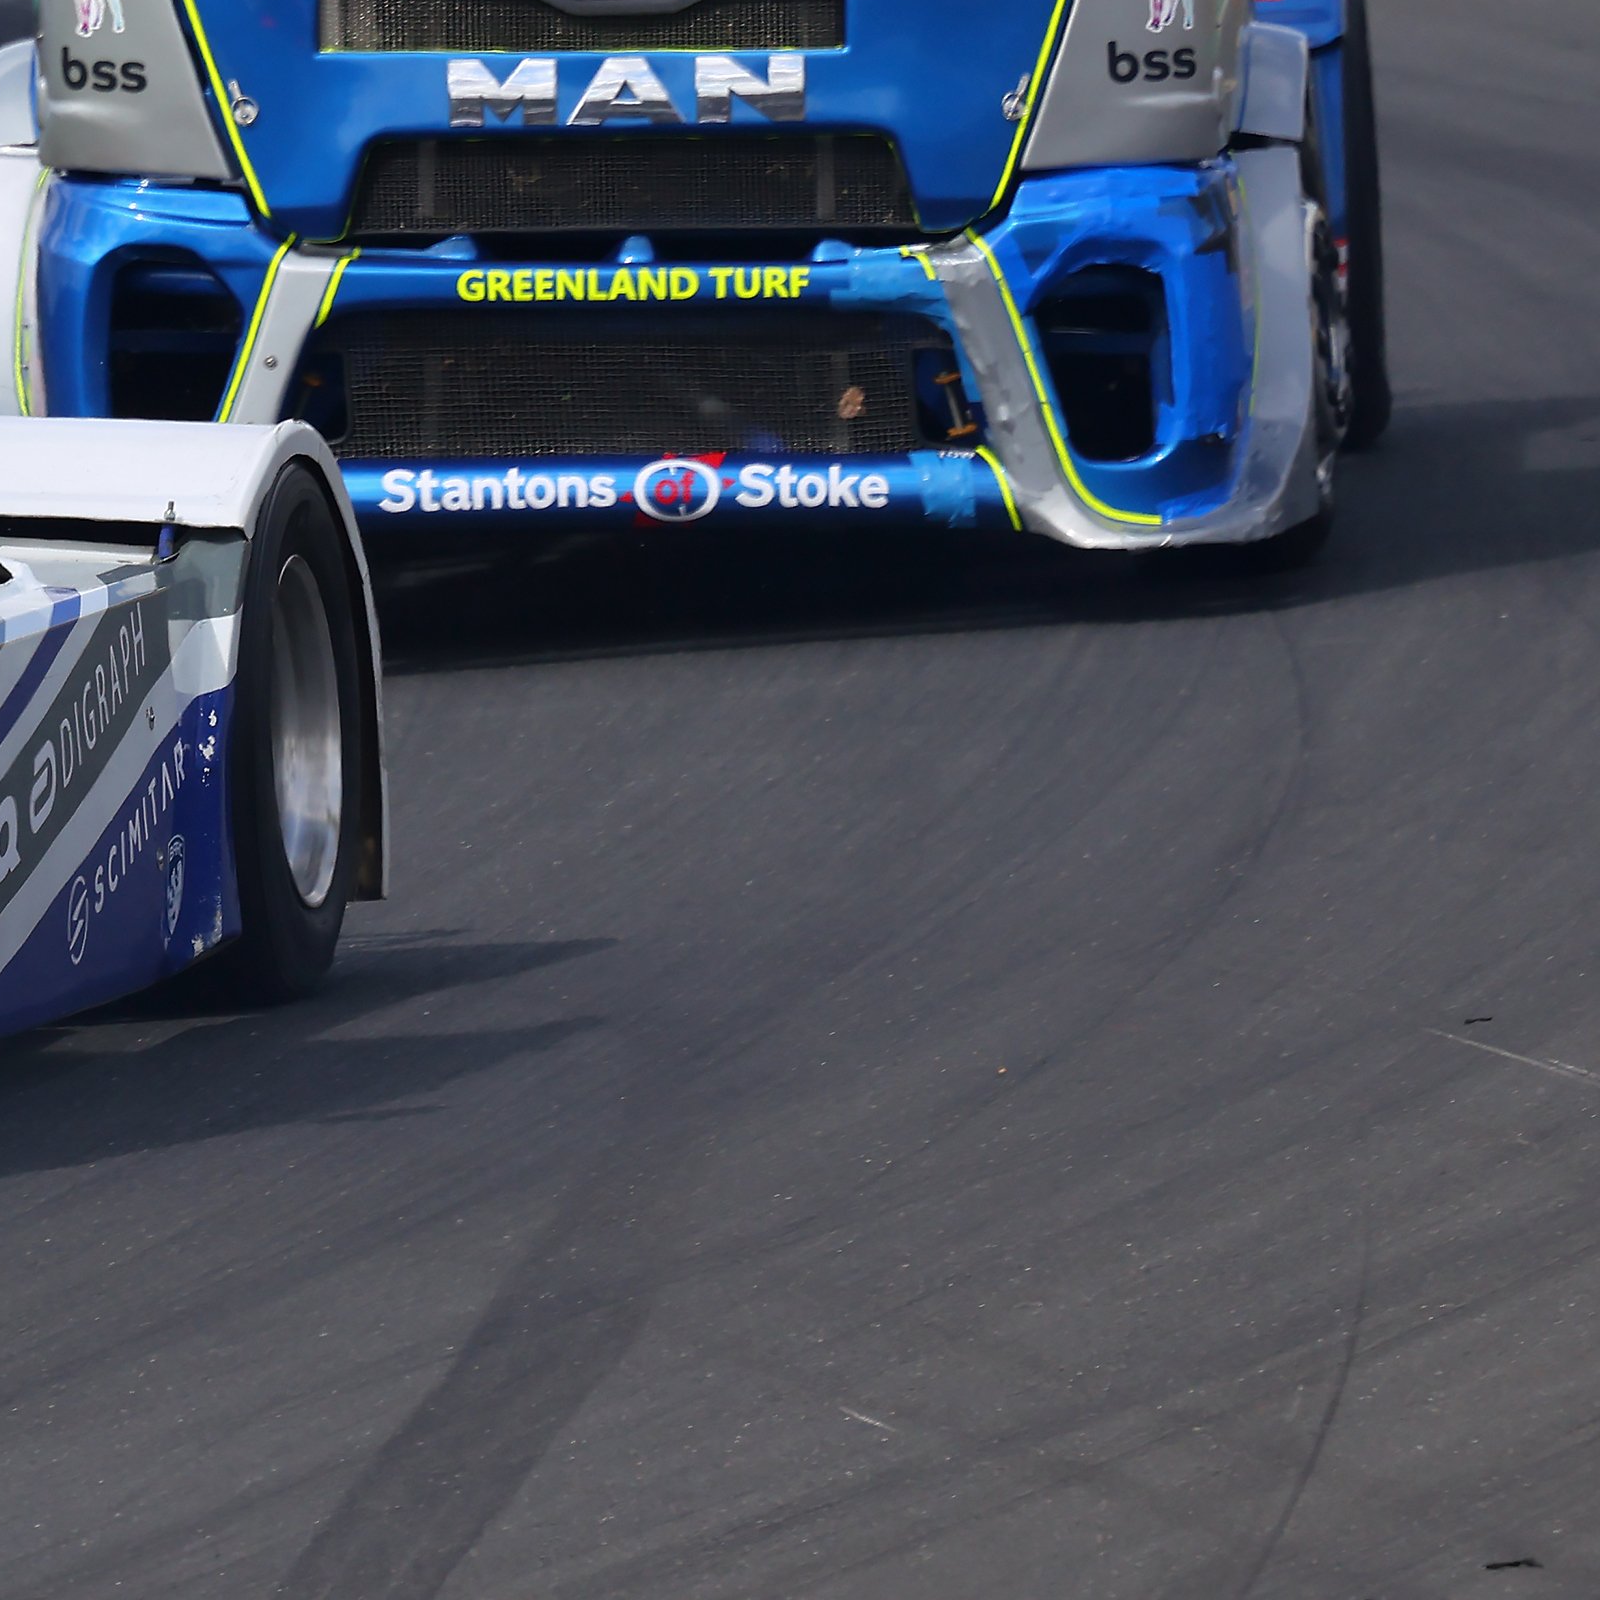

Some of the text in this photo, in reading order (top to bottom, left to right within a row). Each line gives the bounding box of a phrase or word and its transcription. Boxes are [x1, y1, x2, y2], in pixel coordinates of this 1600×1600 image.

[61, 46, 148, 93] bss
[1107, 40, 1197, 84] bss
[446, 54, 807, 128] MAN
[455, 266, 811, 303] GREENLAND TURF
[377, 464, 890, 513] Stantons of Stoke
[60, 601, 147, 789] DIGRAPH
[93, 738, 189, 915] SCIMITAR
